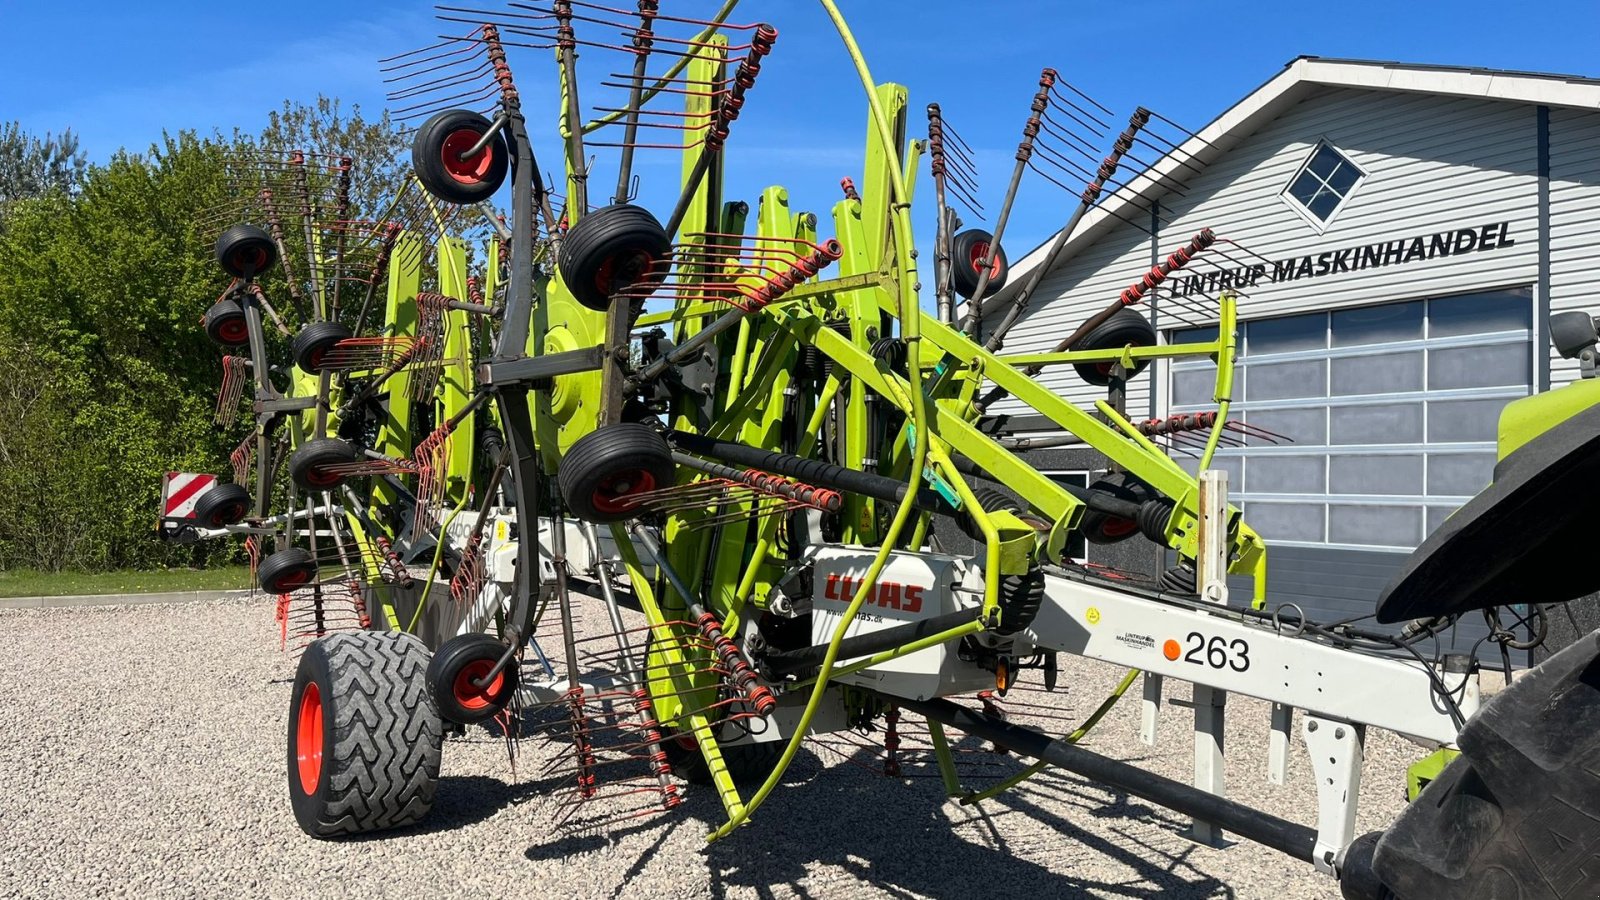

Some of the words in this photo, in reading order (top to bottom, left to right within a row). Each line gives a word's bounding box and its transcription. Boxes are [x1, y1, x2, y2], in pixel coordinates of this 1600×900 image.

[1169, 261, 1267, 299] LINTRUP
[1271, 221, 1516, 284] MASKINHANDEL
[826, 608, 883, 624] www.aas.dk
[1184, 631, 1251, 673] 263
